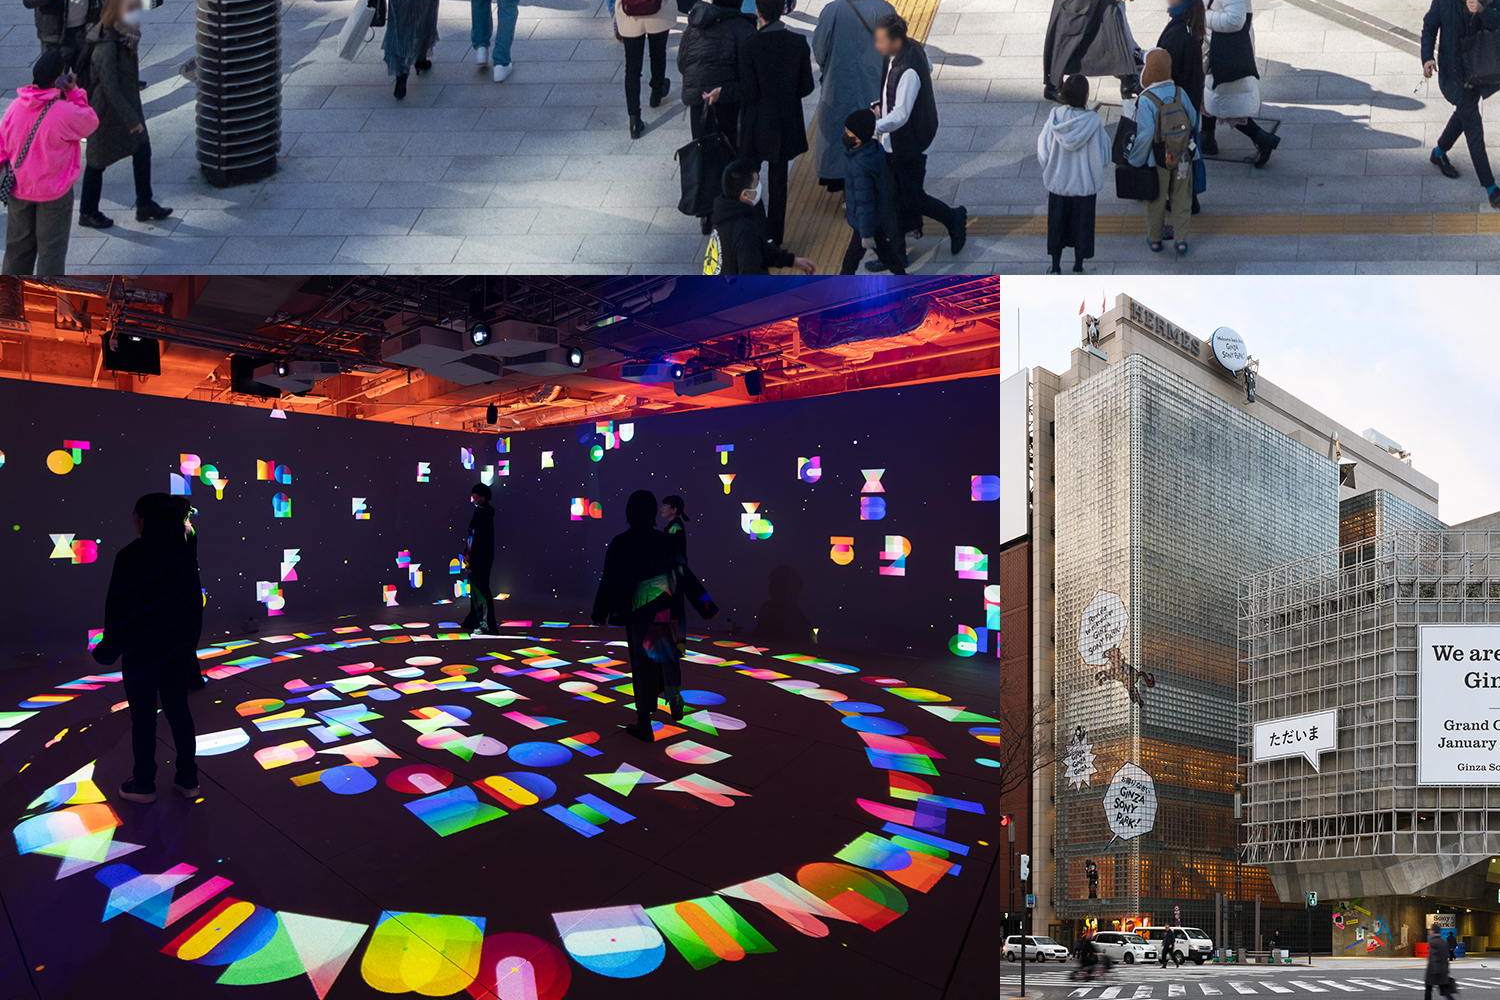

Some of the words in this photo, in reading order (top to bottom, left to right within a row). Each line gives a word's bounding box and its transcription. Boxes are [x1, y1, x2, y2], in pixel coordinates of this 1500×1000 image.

[1432, 644, 1465, 662] We
[1443, 719, 1490, 731] Grand
[1269, 725, 1319, 747] ただいま
[1437, 736, 1497, 751] January
[1457, 762, 1487, 772] Ginza
[1120, 786, 1146, 805] GINZA
[1114, 797, 1139, 814] SONY
[1116, 812, 1142, 829] PARK!
